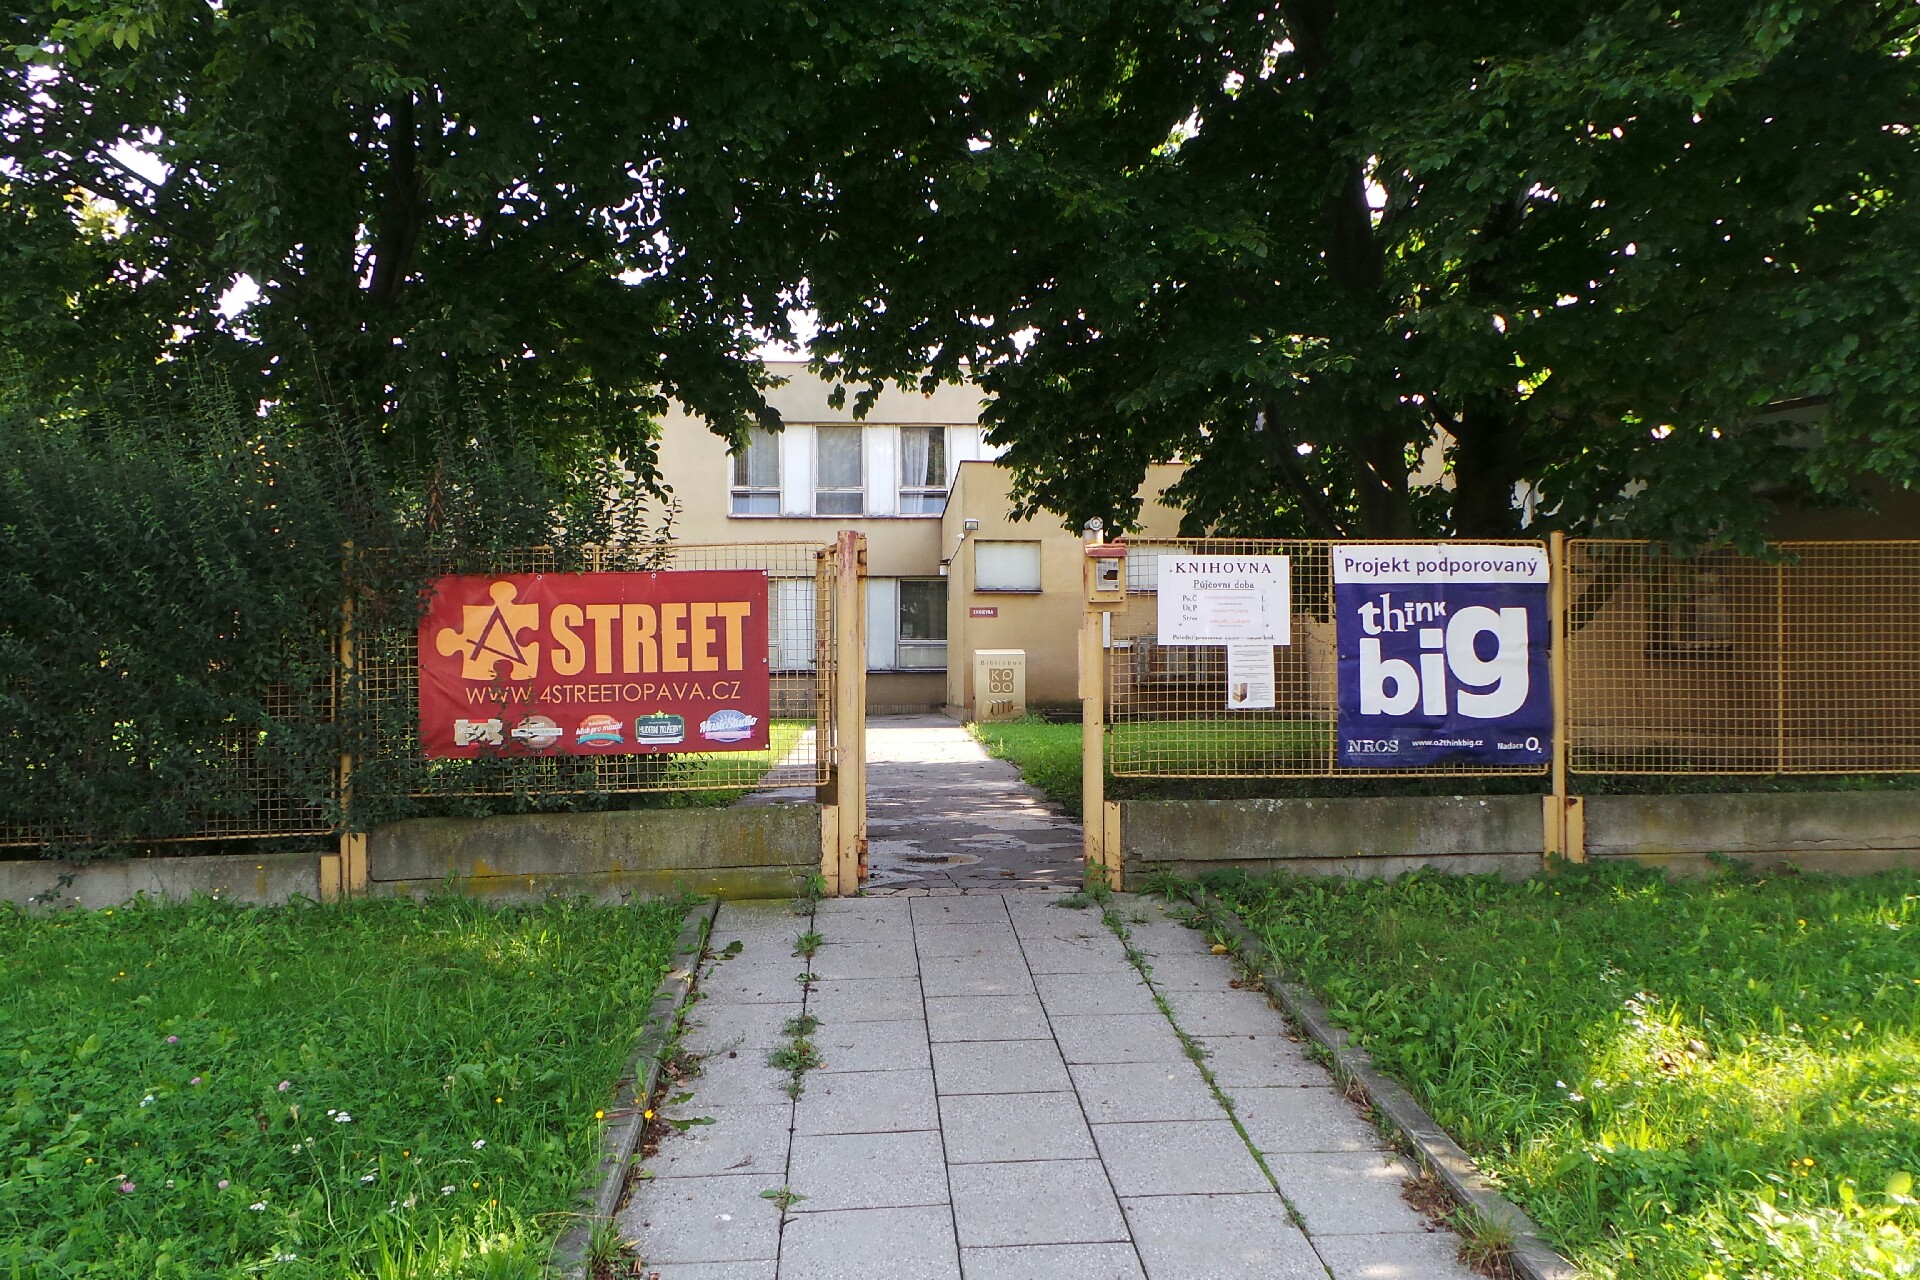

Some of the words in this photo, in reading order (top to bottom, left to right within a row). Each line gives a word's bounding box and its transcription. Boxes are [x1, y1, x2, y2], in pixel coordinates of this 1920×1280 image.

[1175, 562, 1272, 574] KNIHOVNA
[1344, 557, 1411, 577] Projekt
[1416, 556, 1538, 577] podporovaný
[1234, 580, 1255, 588] doba
[1357, 592, 1447, 636] think
[550, 602, 750, 675] STREET
[1359, 605, 1530, 719] big
[1411, 739, 1484, 748] www.o2thinkbig.cz
[1497, 742, 1524, 750] Nadace
